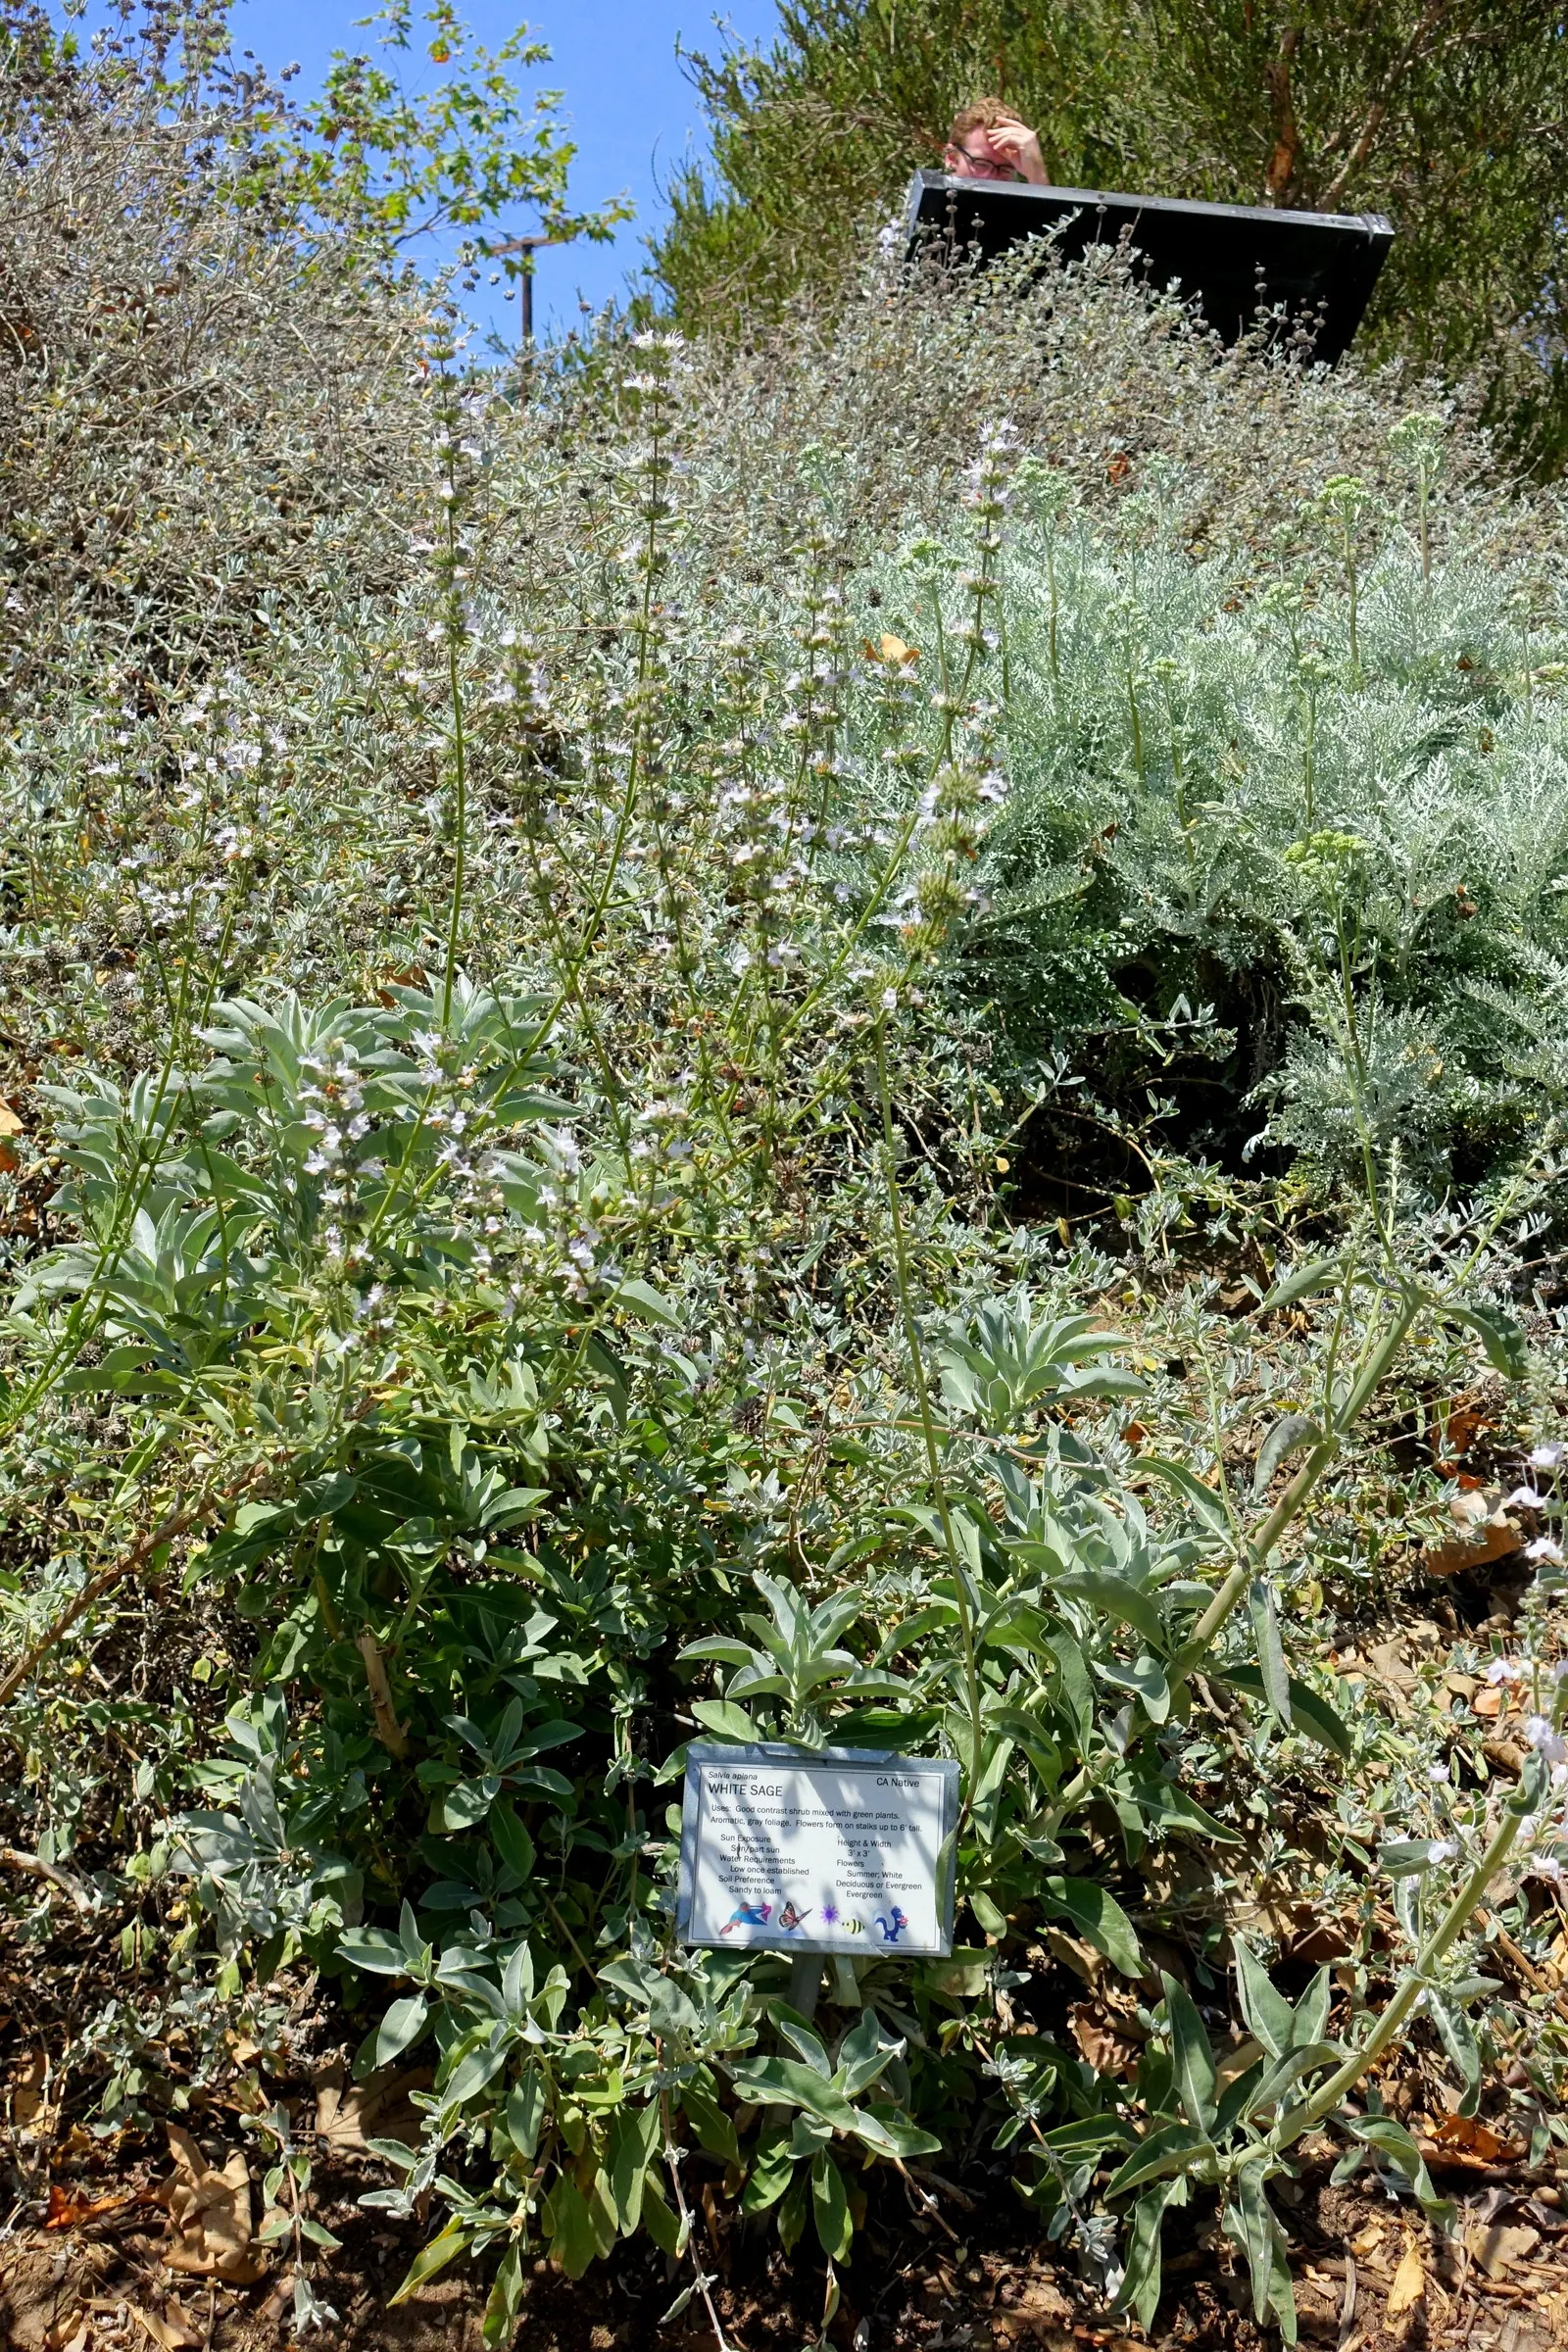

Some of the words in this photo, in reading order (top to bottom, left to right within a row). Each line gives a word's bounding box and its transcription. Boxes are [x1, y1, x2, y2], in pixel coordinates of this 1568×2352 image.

[877, 1778, 888, 1786] CA
[891, 1778, 920, 1788] Native
[708, 1783, 747, 1795] WHITE
[750, 1785, 783, 1796] SAGE
[710, 1816, 745, 1825] Aromatic,
[765, 1818, 791, 1827] foliage.
[795, 1819, 824, 1828] Flowers
[856, 1822, 877, 1830] stalks
[737, 1835, 771, 1843] Exposure
[837, 1839, 861, 1848] Height
[743, 1856, 795, 1864] Requirements
[767, 1867, 809, 1875] established
[735, 1875, 775, 1884] Preference
[836, 1880, 875, 1888] Deciduous
[885, 1882, 922, 1890] Evergreen
[729, 1886, 752, 1894] Sandy
[846, 1890, 882, 1899] Evergreen
